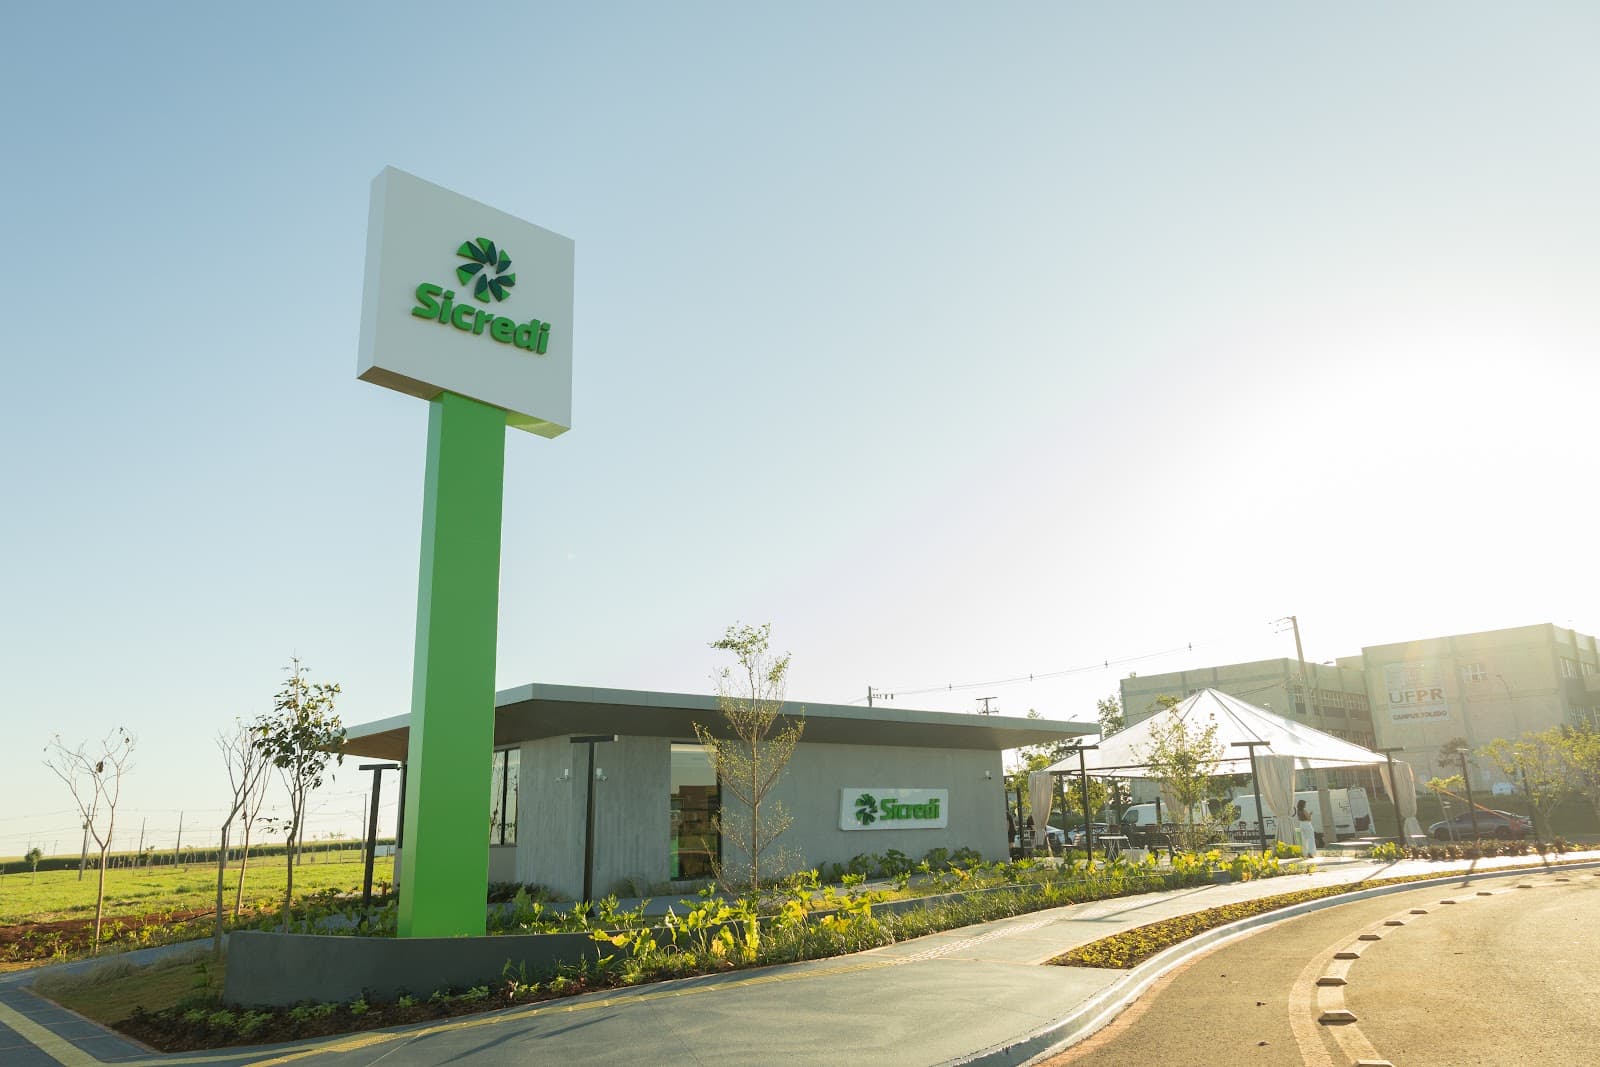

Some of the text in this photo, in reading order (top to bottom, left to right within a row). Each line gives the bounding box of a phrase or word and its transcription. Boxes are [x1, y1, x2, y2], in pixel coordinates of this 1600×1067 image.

[411, 282, 551, 355] Sicredi
[1388, 688, 1444, 704] UFPR
[880, 798, 940, 820] Sicredi
